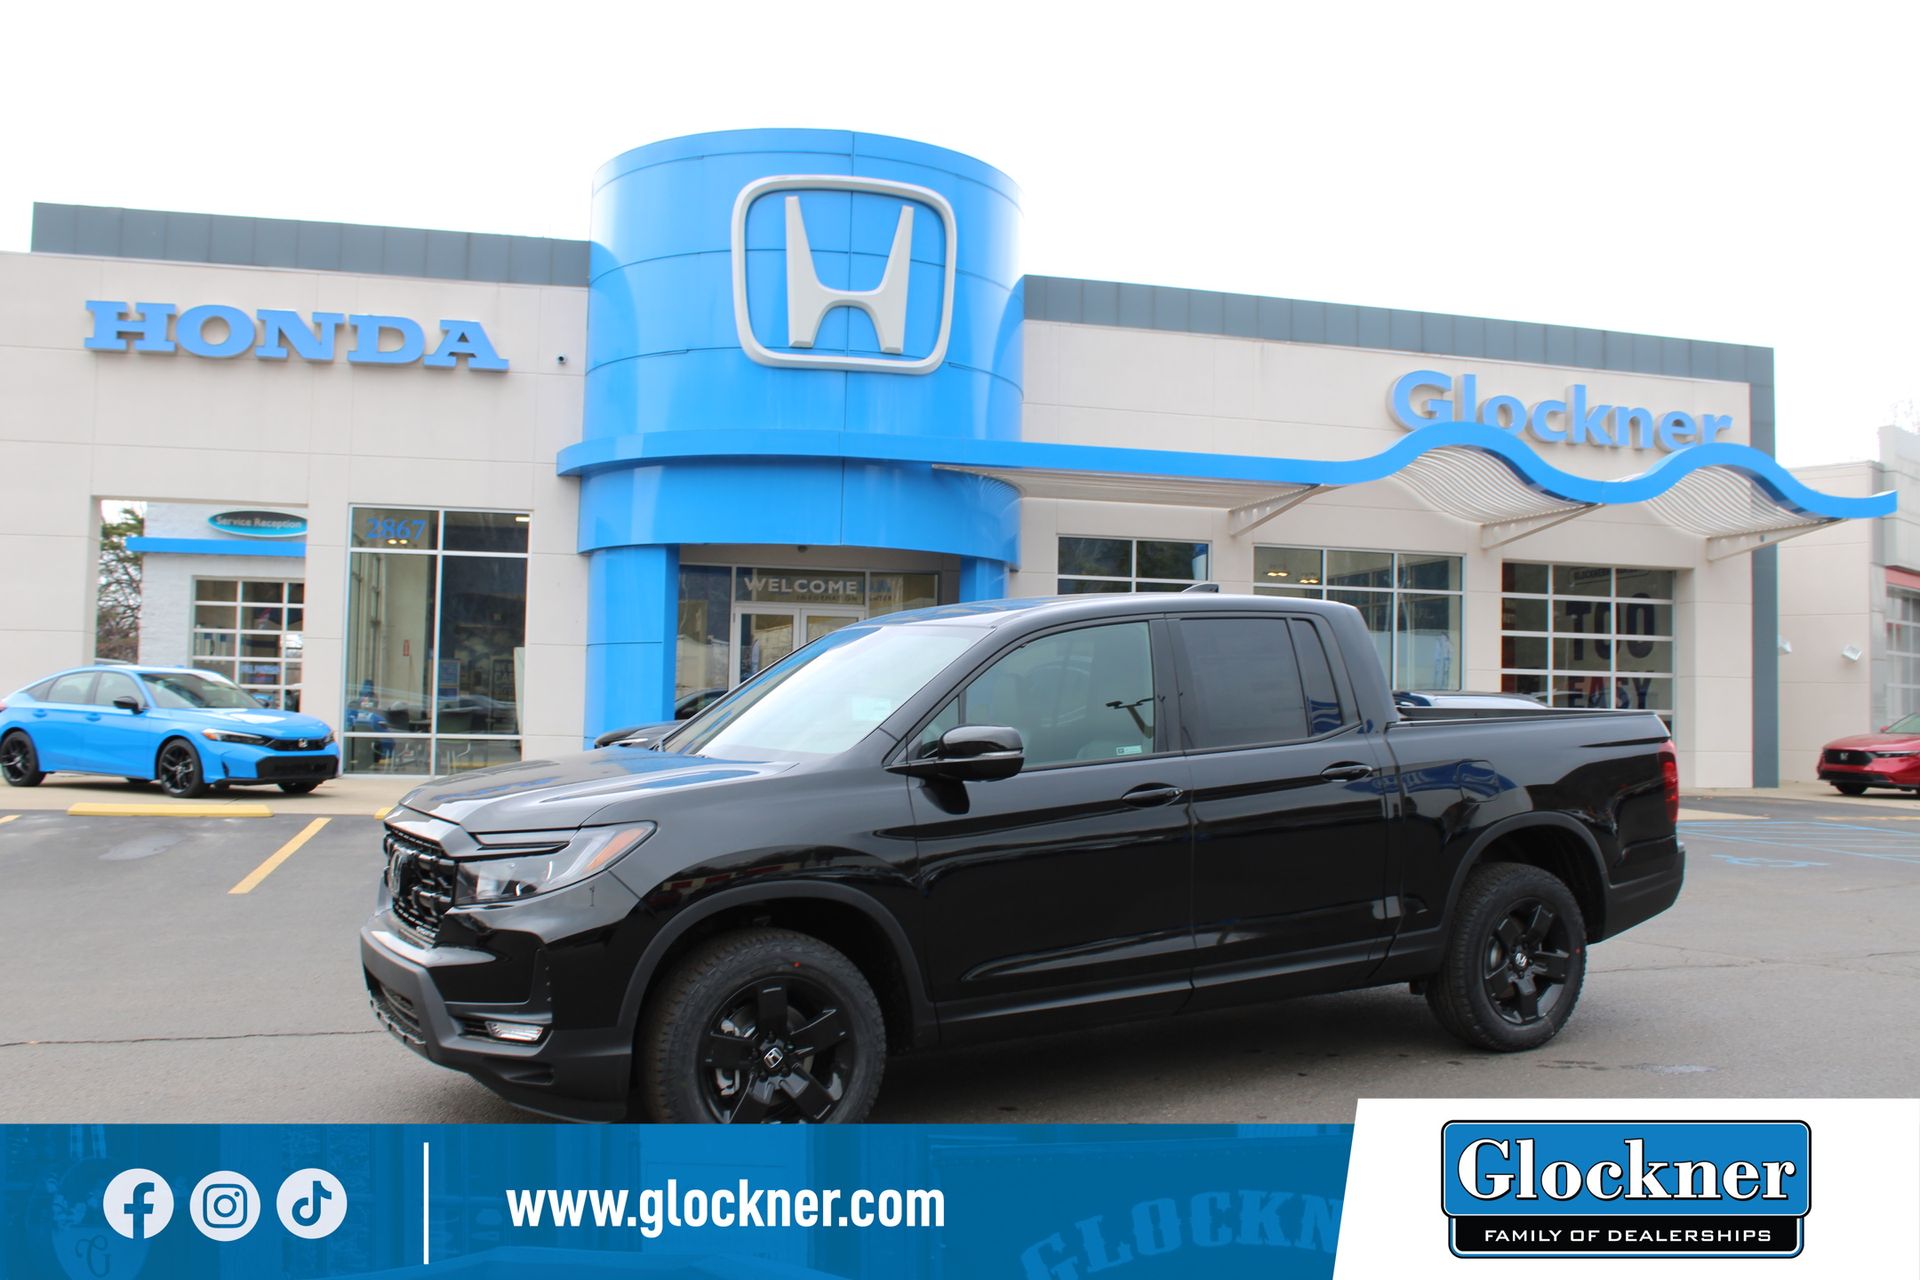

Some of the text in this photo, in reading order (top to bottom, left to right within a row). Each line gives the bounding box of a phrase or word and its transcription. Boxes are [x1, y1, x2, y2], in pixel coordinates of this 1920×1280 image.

[84, 300, 510, 371] HONDA
[1388, 370, 1733, 450] Glockner
[215, 515, 302, 530] Service Reception
[366, 517, 427, 541] 2867
[743, 576, 858, 595] WELCOME
[1565, 592, 1656, 661] TOO
